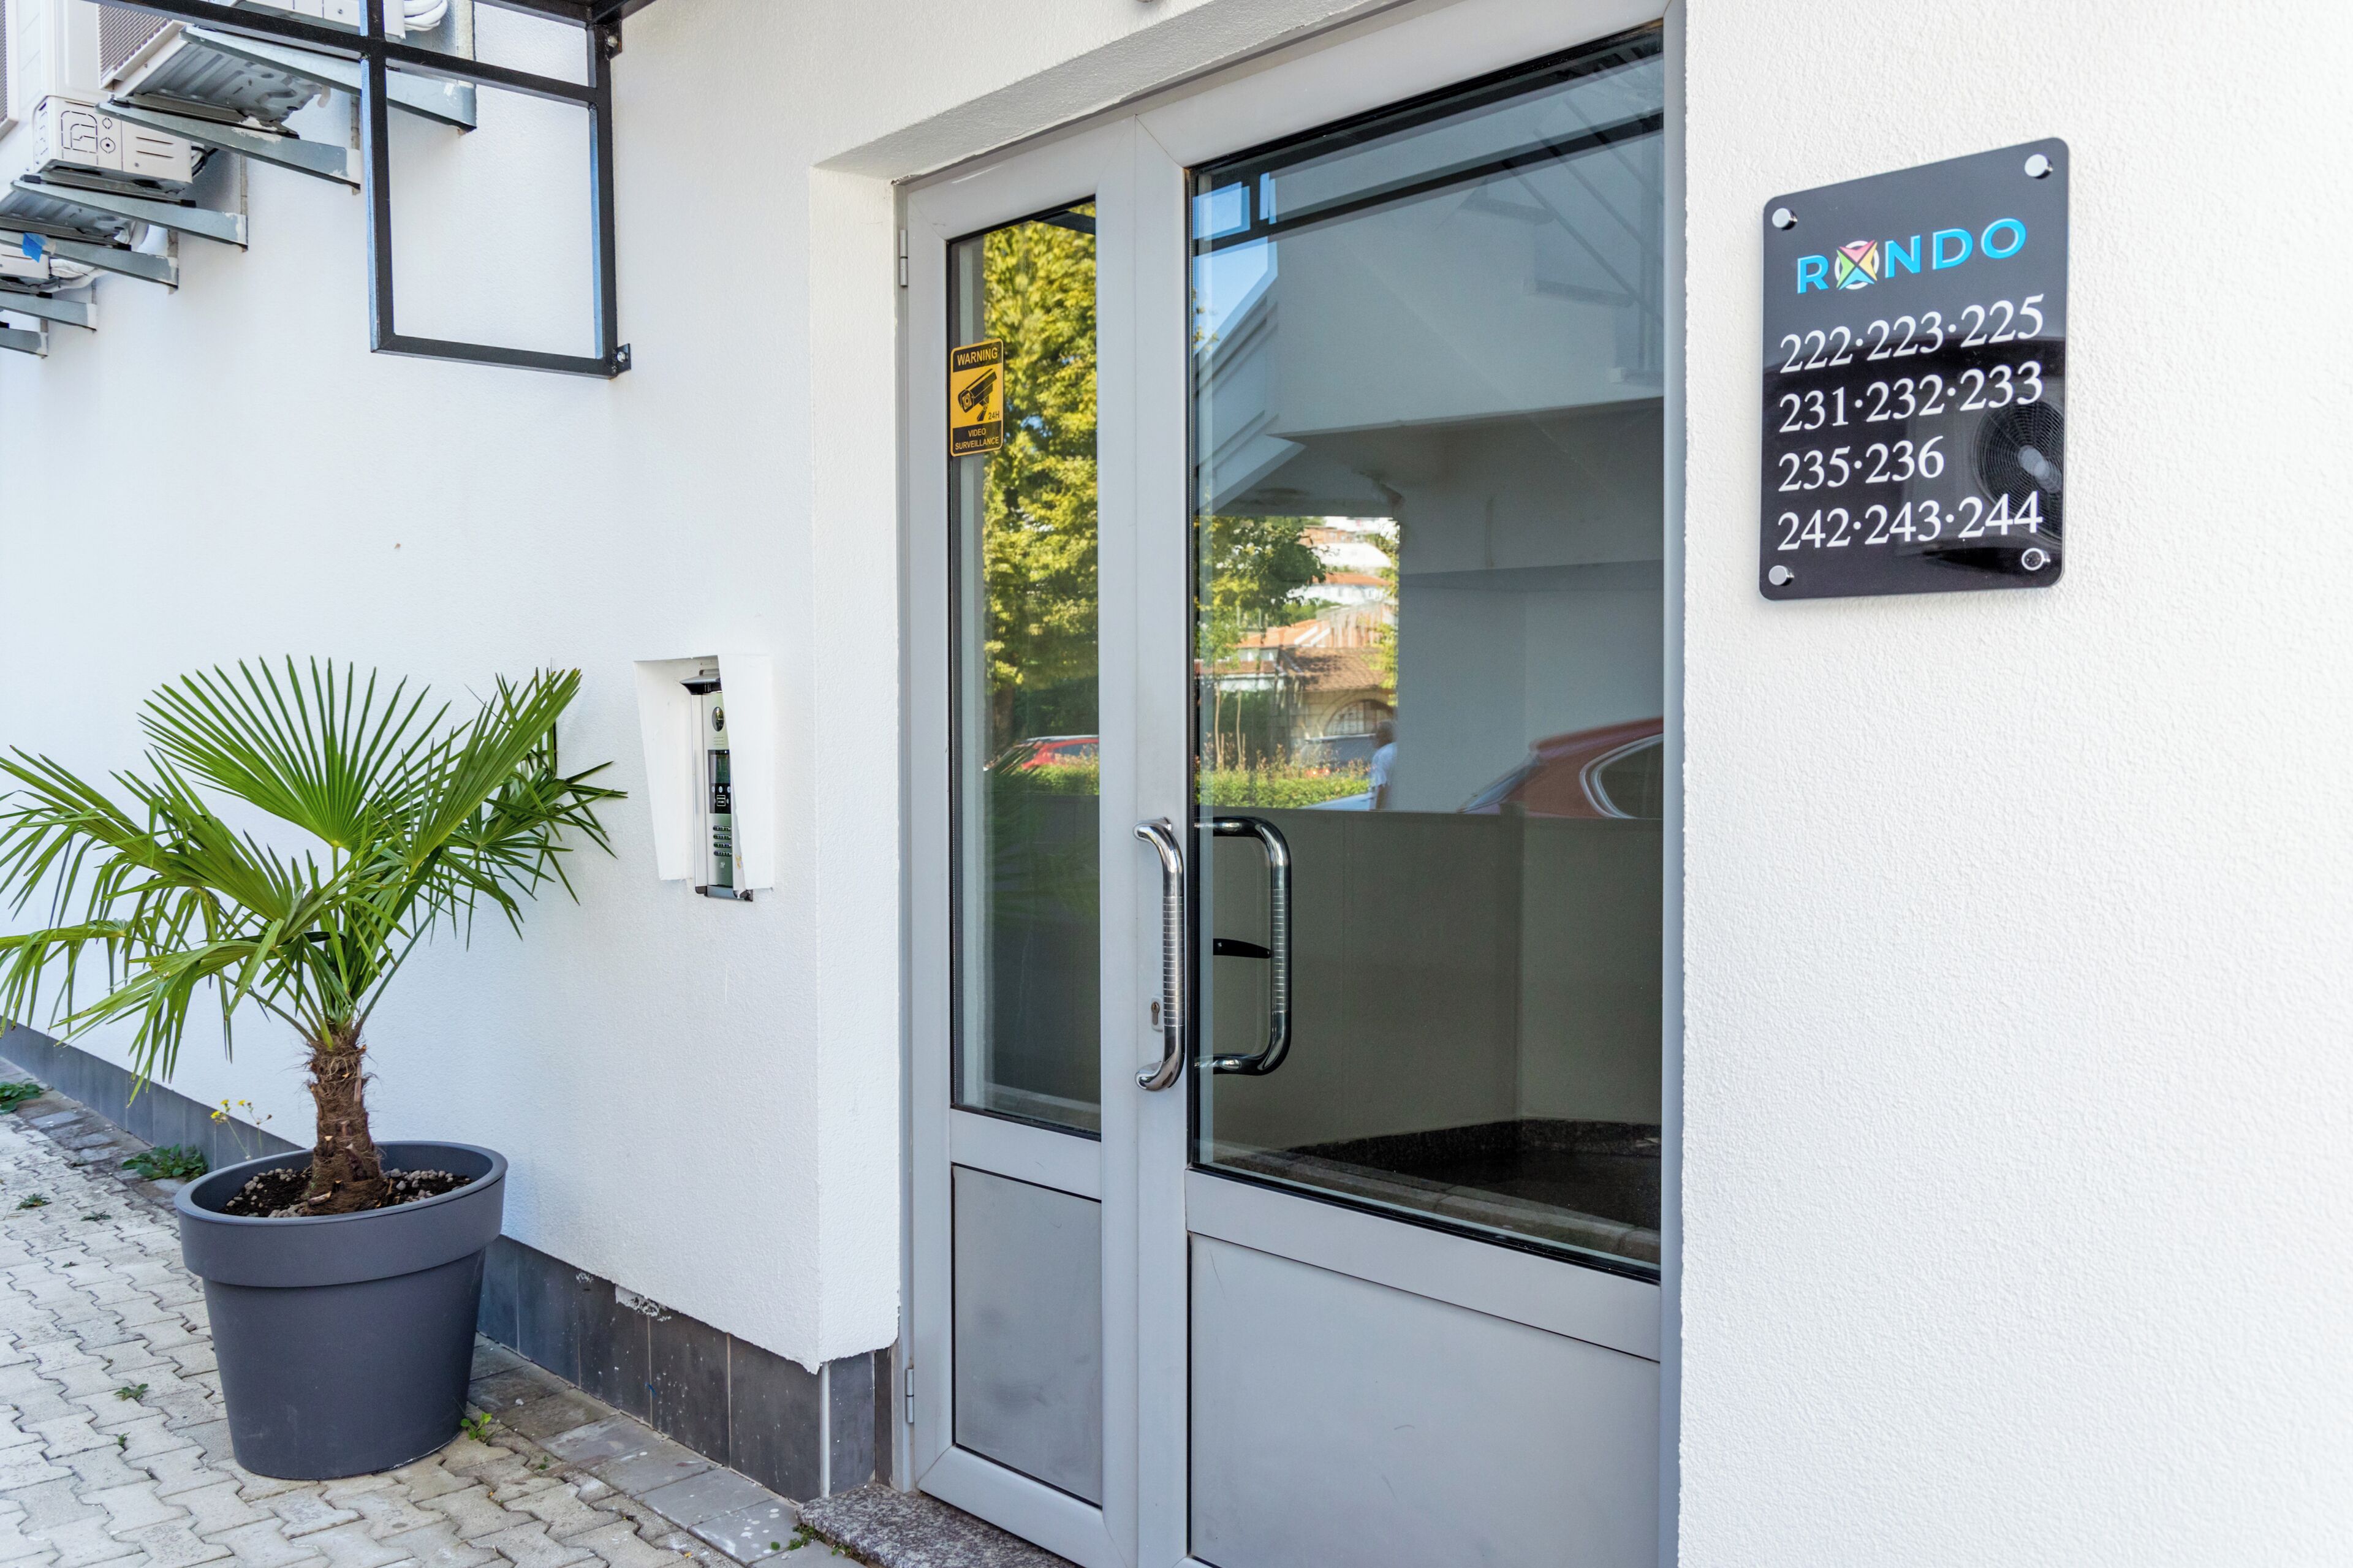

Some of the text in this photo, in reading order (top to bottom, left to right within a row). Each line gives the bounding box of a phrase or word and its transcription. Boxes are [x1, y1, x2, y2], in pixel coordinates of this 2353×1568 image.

[1797, 218, 2026, 294] RONDO
[958, 347, 998, 366] WARNING
[988, 411, 1000, 420] 24H
[968, 428, 986, 437] VIDEO
[955, 437, 999, 450] SURVEILLANCE
